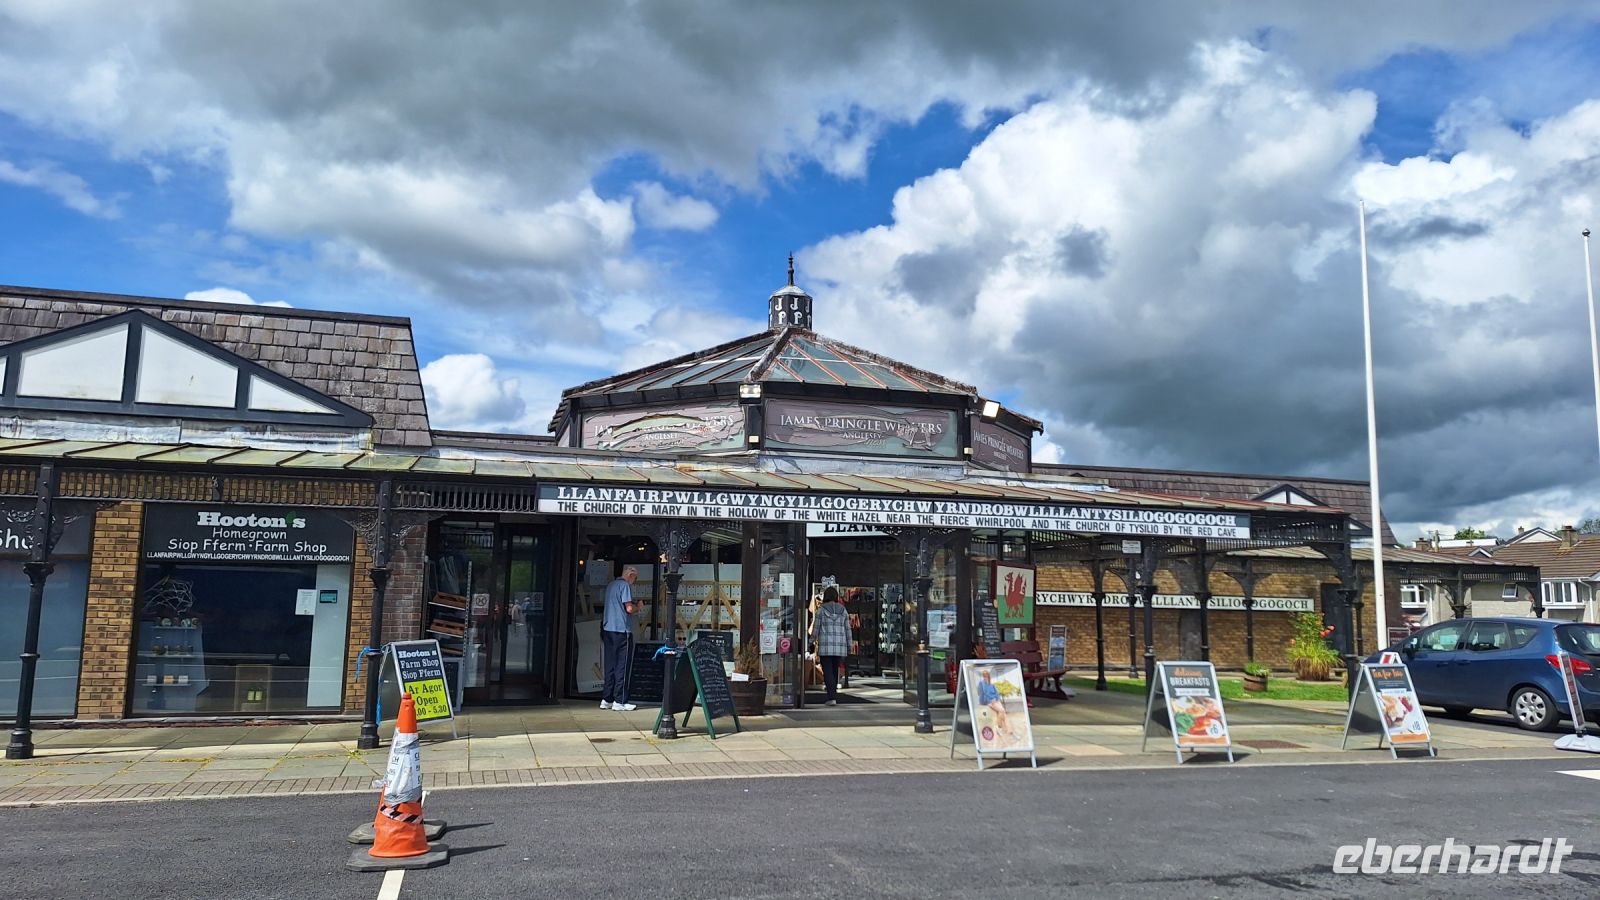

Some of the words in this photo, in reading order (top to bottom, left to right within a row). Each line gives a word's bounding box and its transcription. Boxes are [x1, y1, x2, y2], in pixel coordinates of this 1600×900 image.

[781, 414, 819, 427] JAMES
[825, 417, 881, 431] PRINGLE
[557, 486, 1236, 526] LLANFAIRPWLLGWYNGYLLGOGERYCHWYRNDROBWLLLLANTYSILIOGOGOGOCH
[558, 501, 577, 512] THE
[584, 502, 626, 514] CHURCH
[633, 504, 645, 515] OF
[652, 505, 682, 516] MARY
[687, 506, 697, 517] IN
[703, 506, 722, 517] THE
[728, 507, 768, 519] HOLLOW
[774, 508, 786, 519] OF
[792, 509, 810, 520] THE
[816, 510, 846, 521] WHITE
[851, 511, 881, 522] HAZEL
[886, 512, 911, 524] NEAR
[917, 514, 934, 525] THE
[940, 515, 969, 526] FIERCE
[975, 516, 1026, 528] WHIRLPOOL
[1031, 518, 1050, 529] AND
[1055, 520, 1071, 530] THE
[1076, 521, 1110, 532] CHURCH
[1115, 522, 1126, 532] OF
[1129, 522, 1159, 534] TYSILIO
[1163, 524, 1174, 535] BY
[1178, 525, 1193, 535] THE
[1197, 526, 1213, 536] RED
[1217, 527, 1237, 537] CAVE
[212, 527, 287, 541] Homegrown
[168, 538, 198, 553] Siop
[203, 539, 246, 552] Fferm
[255, 541, 289, 552] Farm
[294, 541, 327, 556] Shop
[400, 660, 421, 669] Farm
[421, 658, 439, 667] Shop
[402, 671, 418, 680] Siop
[418, 669, 441, 678] Fferm
[408, 685, 419, 695] Ar
[422, 683, 442, 694] Agor
[416, 696, 438, 707] Open
[433, 704, 447, 714] 5.30
